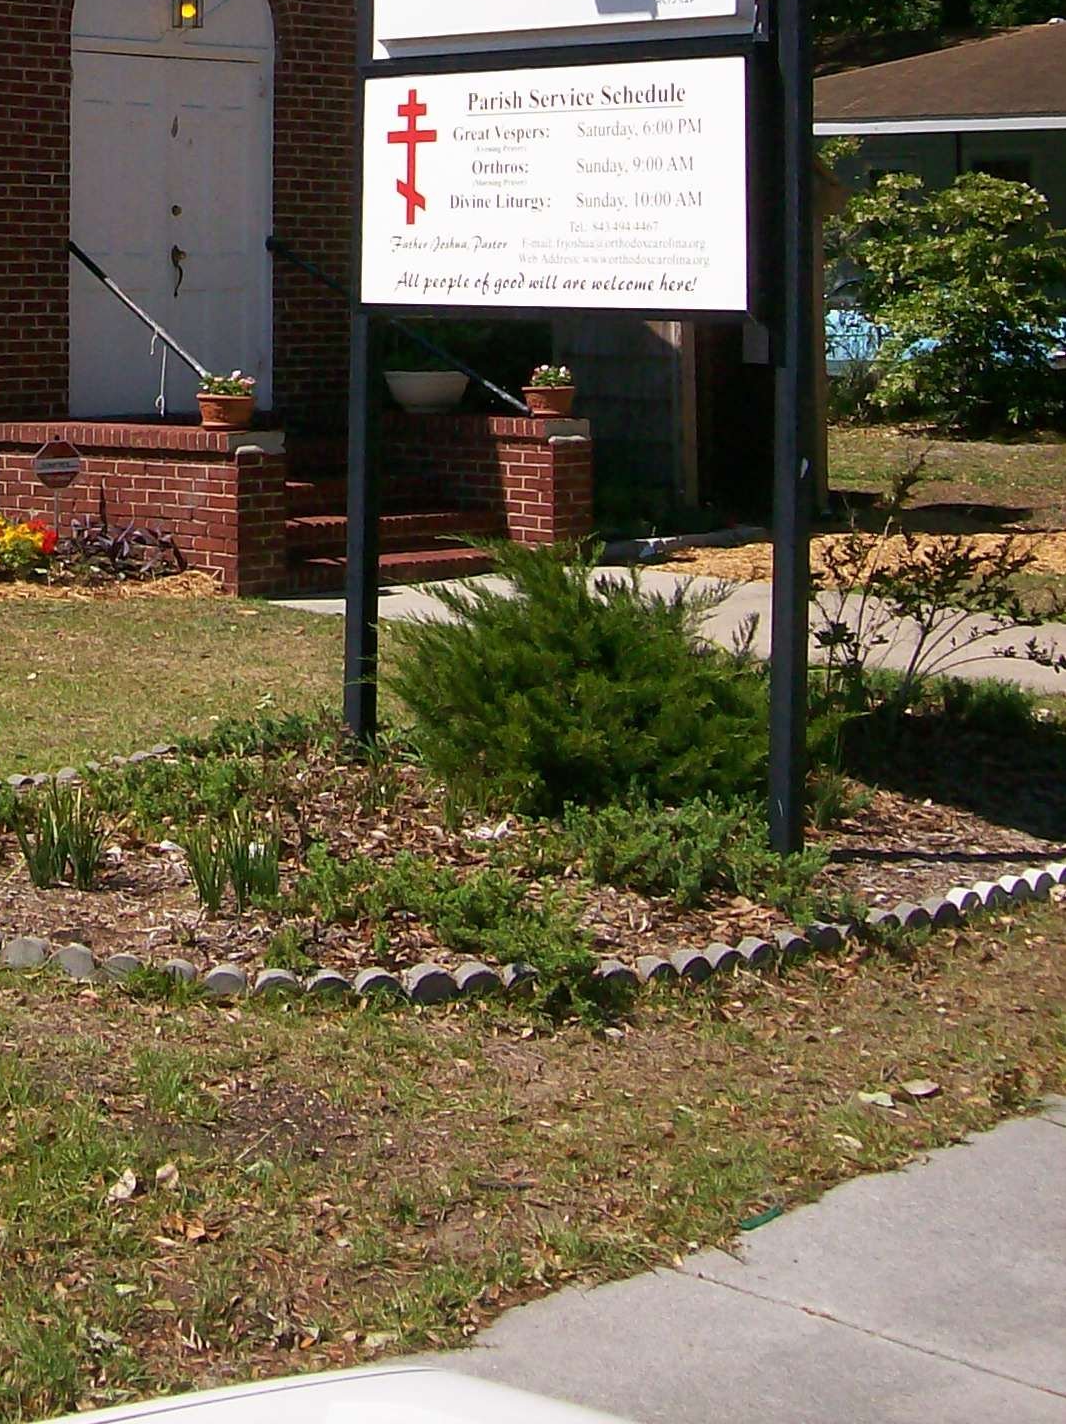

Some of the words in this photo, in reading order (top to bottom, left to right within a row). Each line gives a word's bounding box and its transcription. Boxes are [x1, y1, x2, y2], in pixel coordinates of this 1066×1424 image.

[467, 90, 522, 111] Parish
[528, 85, 594, 109] Service
[601, 82, 686, 105] Schedule
[452, 127, 489, 141] Great
[494, 125, 550, 143] Vespers:
[576, 120, 638, 140] Saturday,
[642, 118, 673, 135] 6:00
[678, 117, 702, 135] PM
[471, 160, 529, 175] Orthros:
[576, 157, 628, 177] Sunday,
[632, 155, 663, 172] 9:00
[666, 155, 694, 172] AM
[450, 193, 491, 209] Divine
[496, 193, 551, 212] Liturgy:
[576, 191, 628, 212] Sunday,
[634, 191, 671, 208] 10:00
[675, 190, 702, 207] AM
[390, 235, 428, 253] Father
[470, 234, 509, 253] Pastor
[519, 254, 538, 264] Web
[394, 271, 420, 293] All
[422, 274, 469, 296] people
[474, 272, 490, 296] of
[494, 272, 525, 295] good
[528, 274, 558, 290] will
[562, 278, 587, 290] are
[590, 275, 654, 291] welcome
[659, 272, 698, 293] here!
